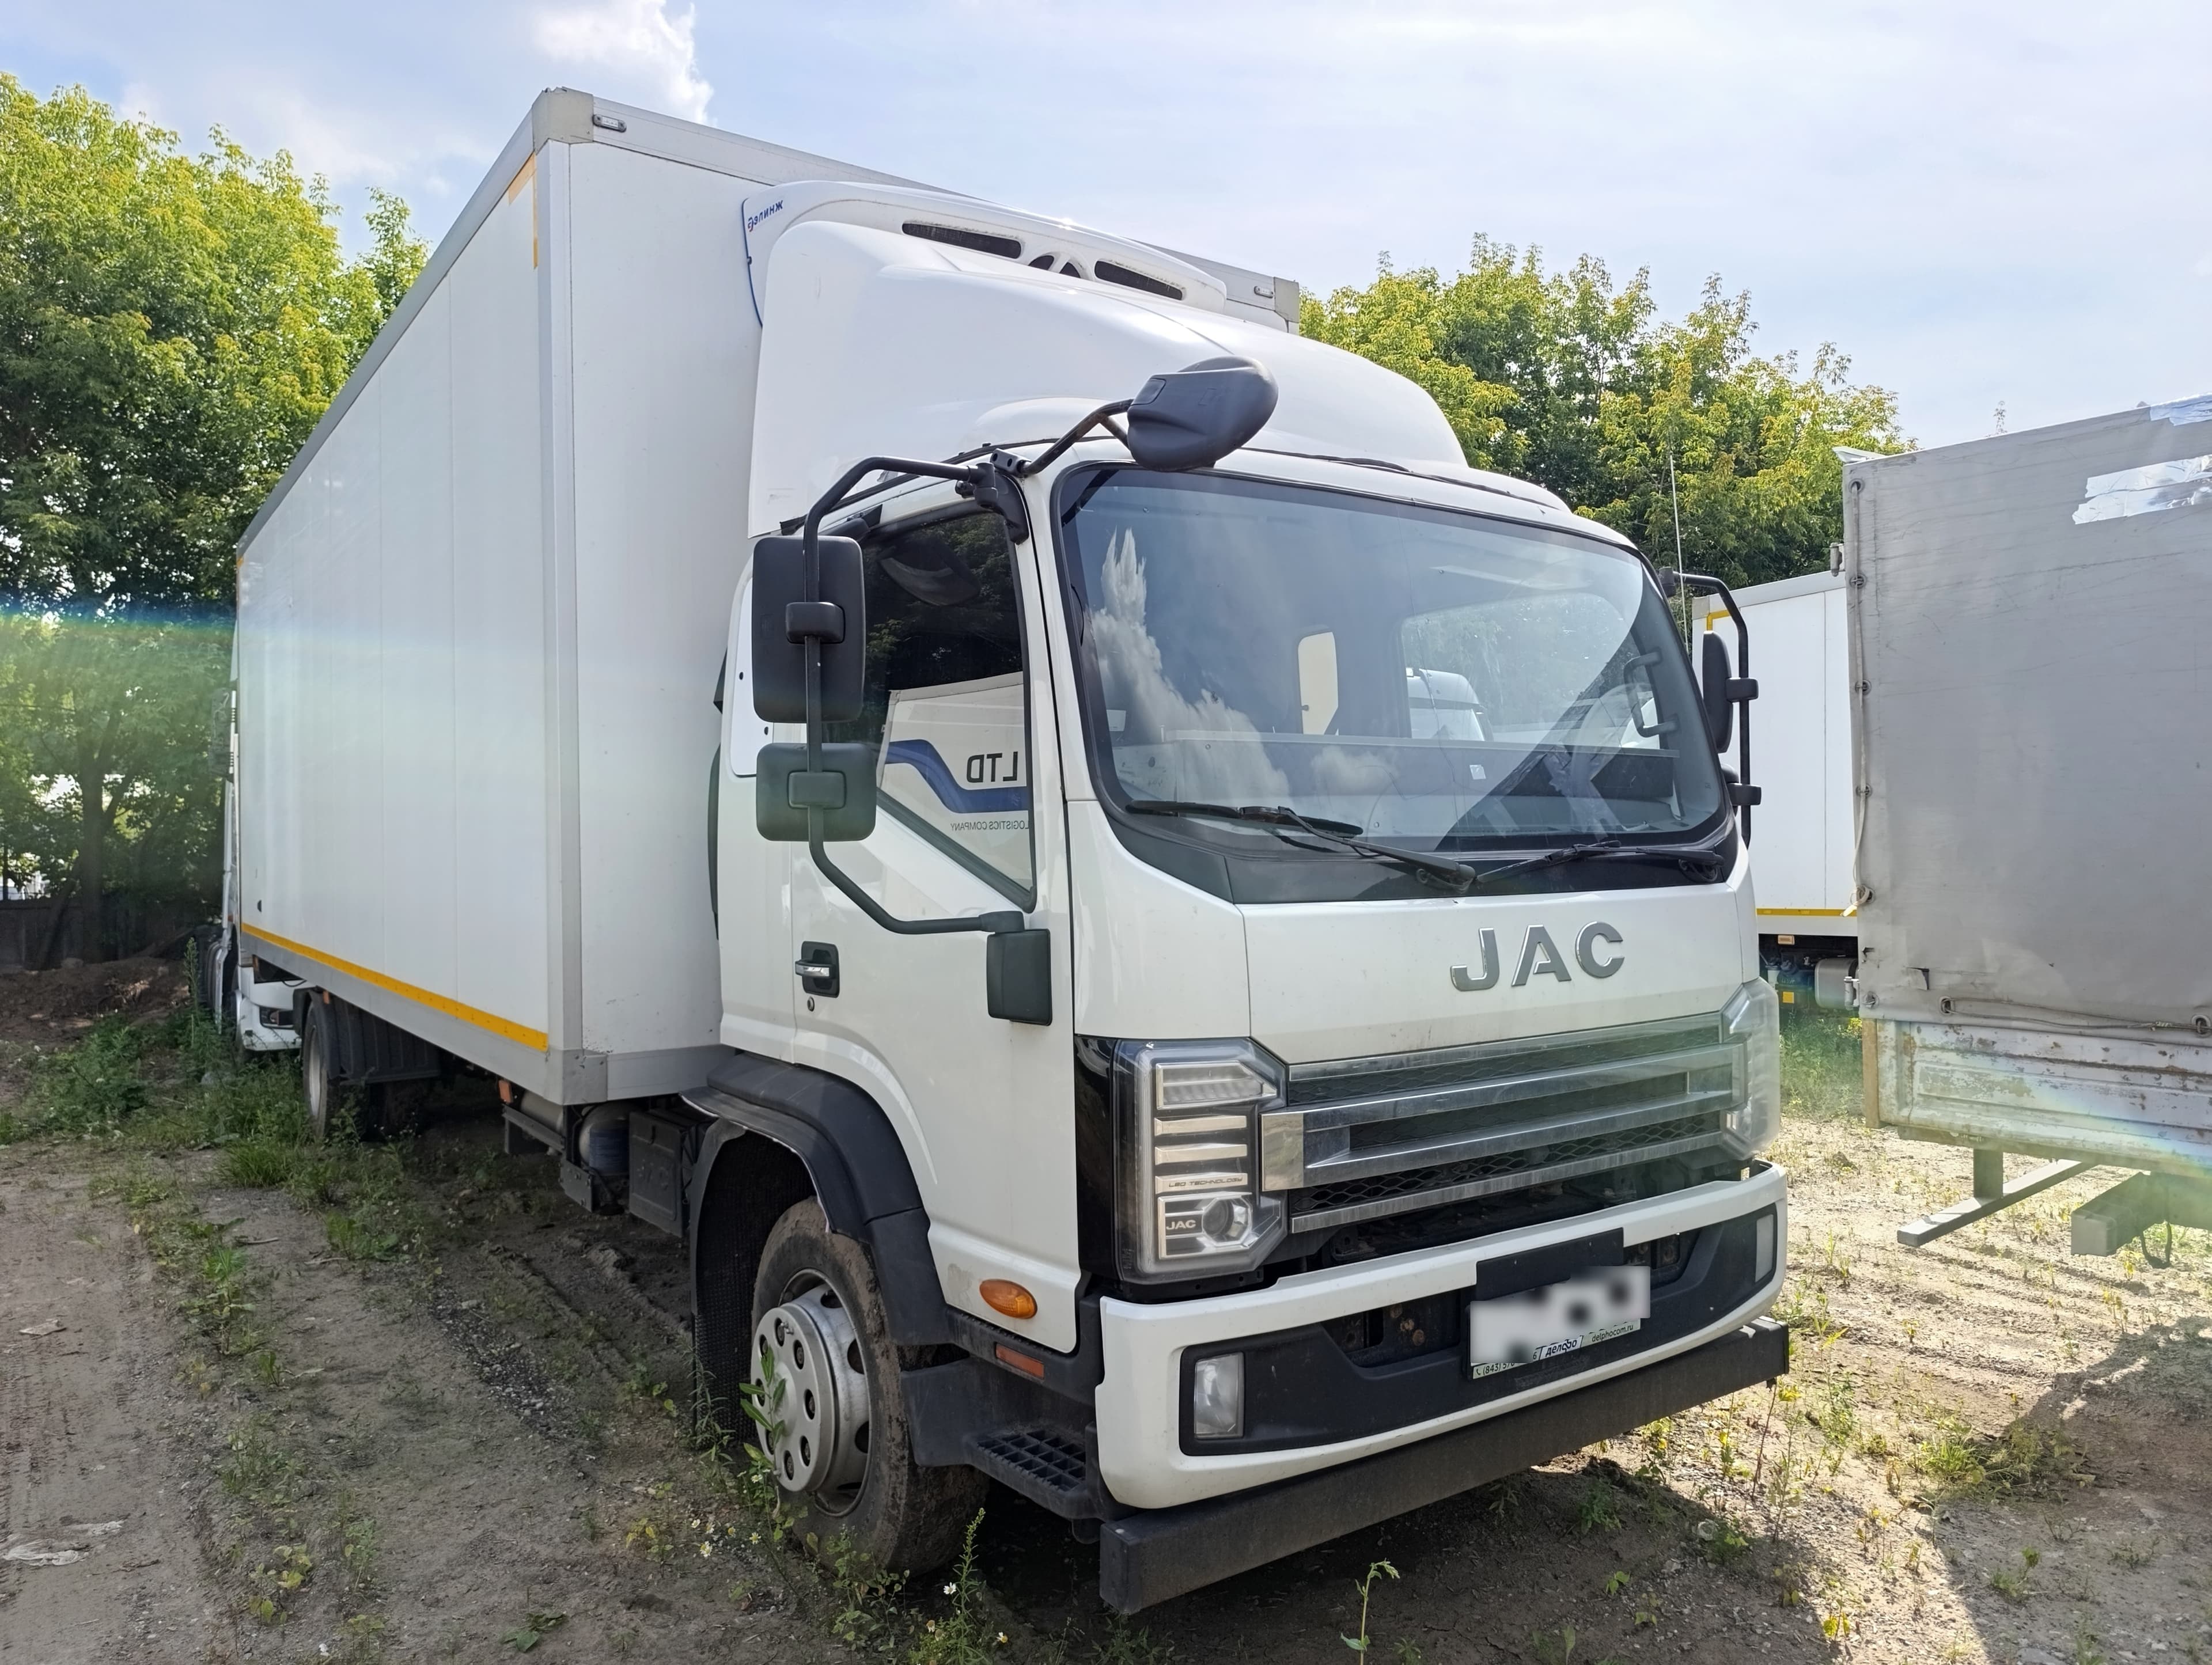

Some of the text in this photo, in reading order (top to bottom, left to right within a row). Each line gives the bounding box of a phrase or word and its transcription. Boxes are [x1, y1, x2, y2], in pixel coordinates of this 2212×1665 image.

[1450, 920, 1625, 992] JAC
[1189, 1178, 1243, 1186] TECHNOLOGY
[1165, 1219, 1196, 1230] JAC
[1591, 1324, 1634, 1342] delphocom.ru
